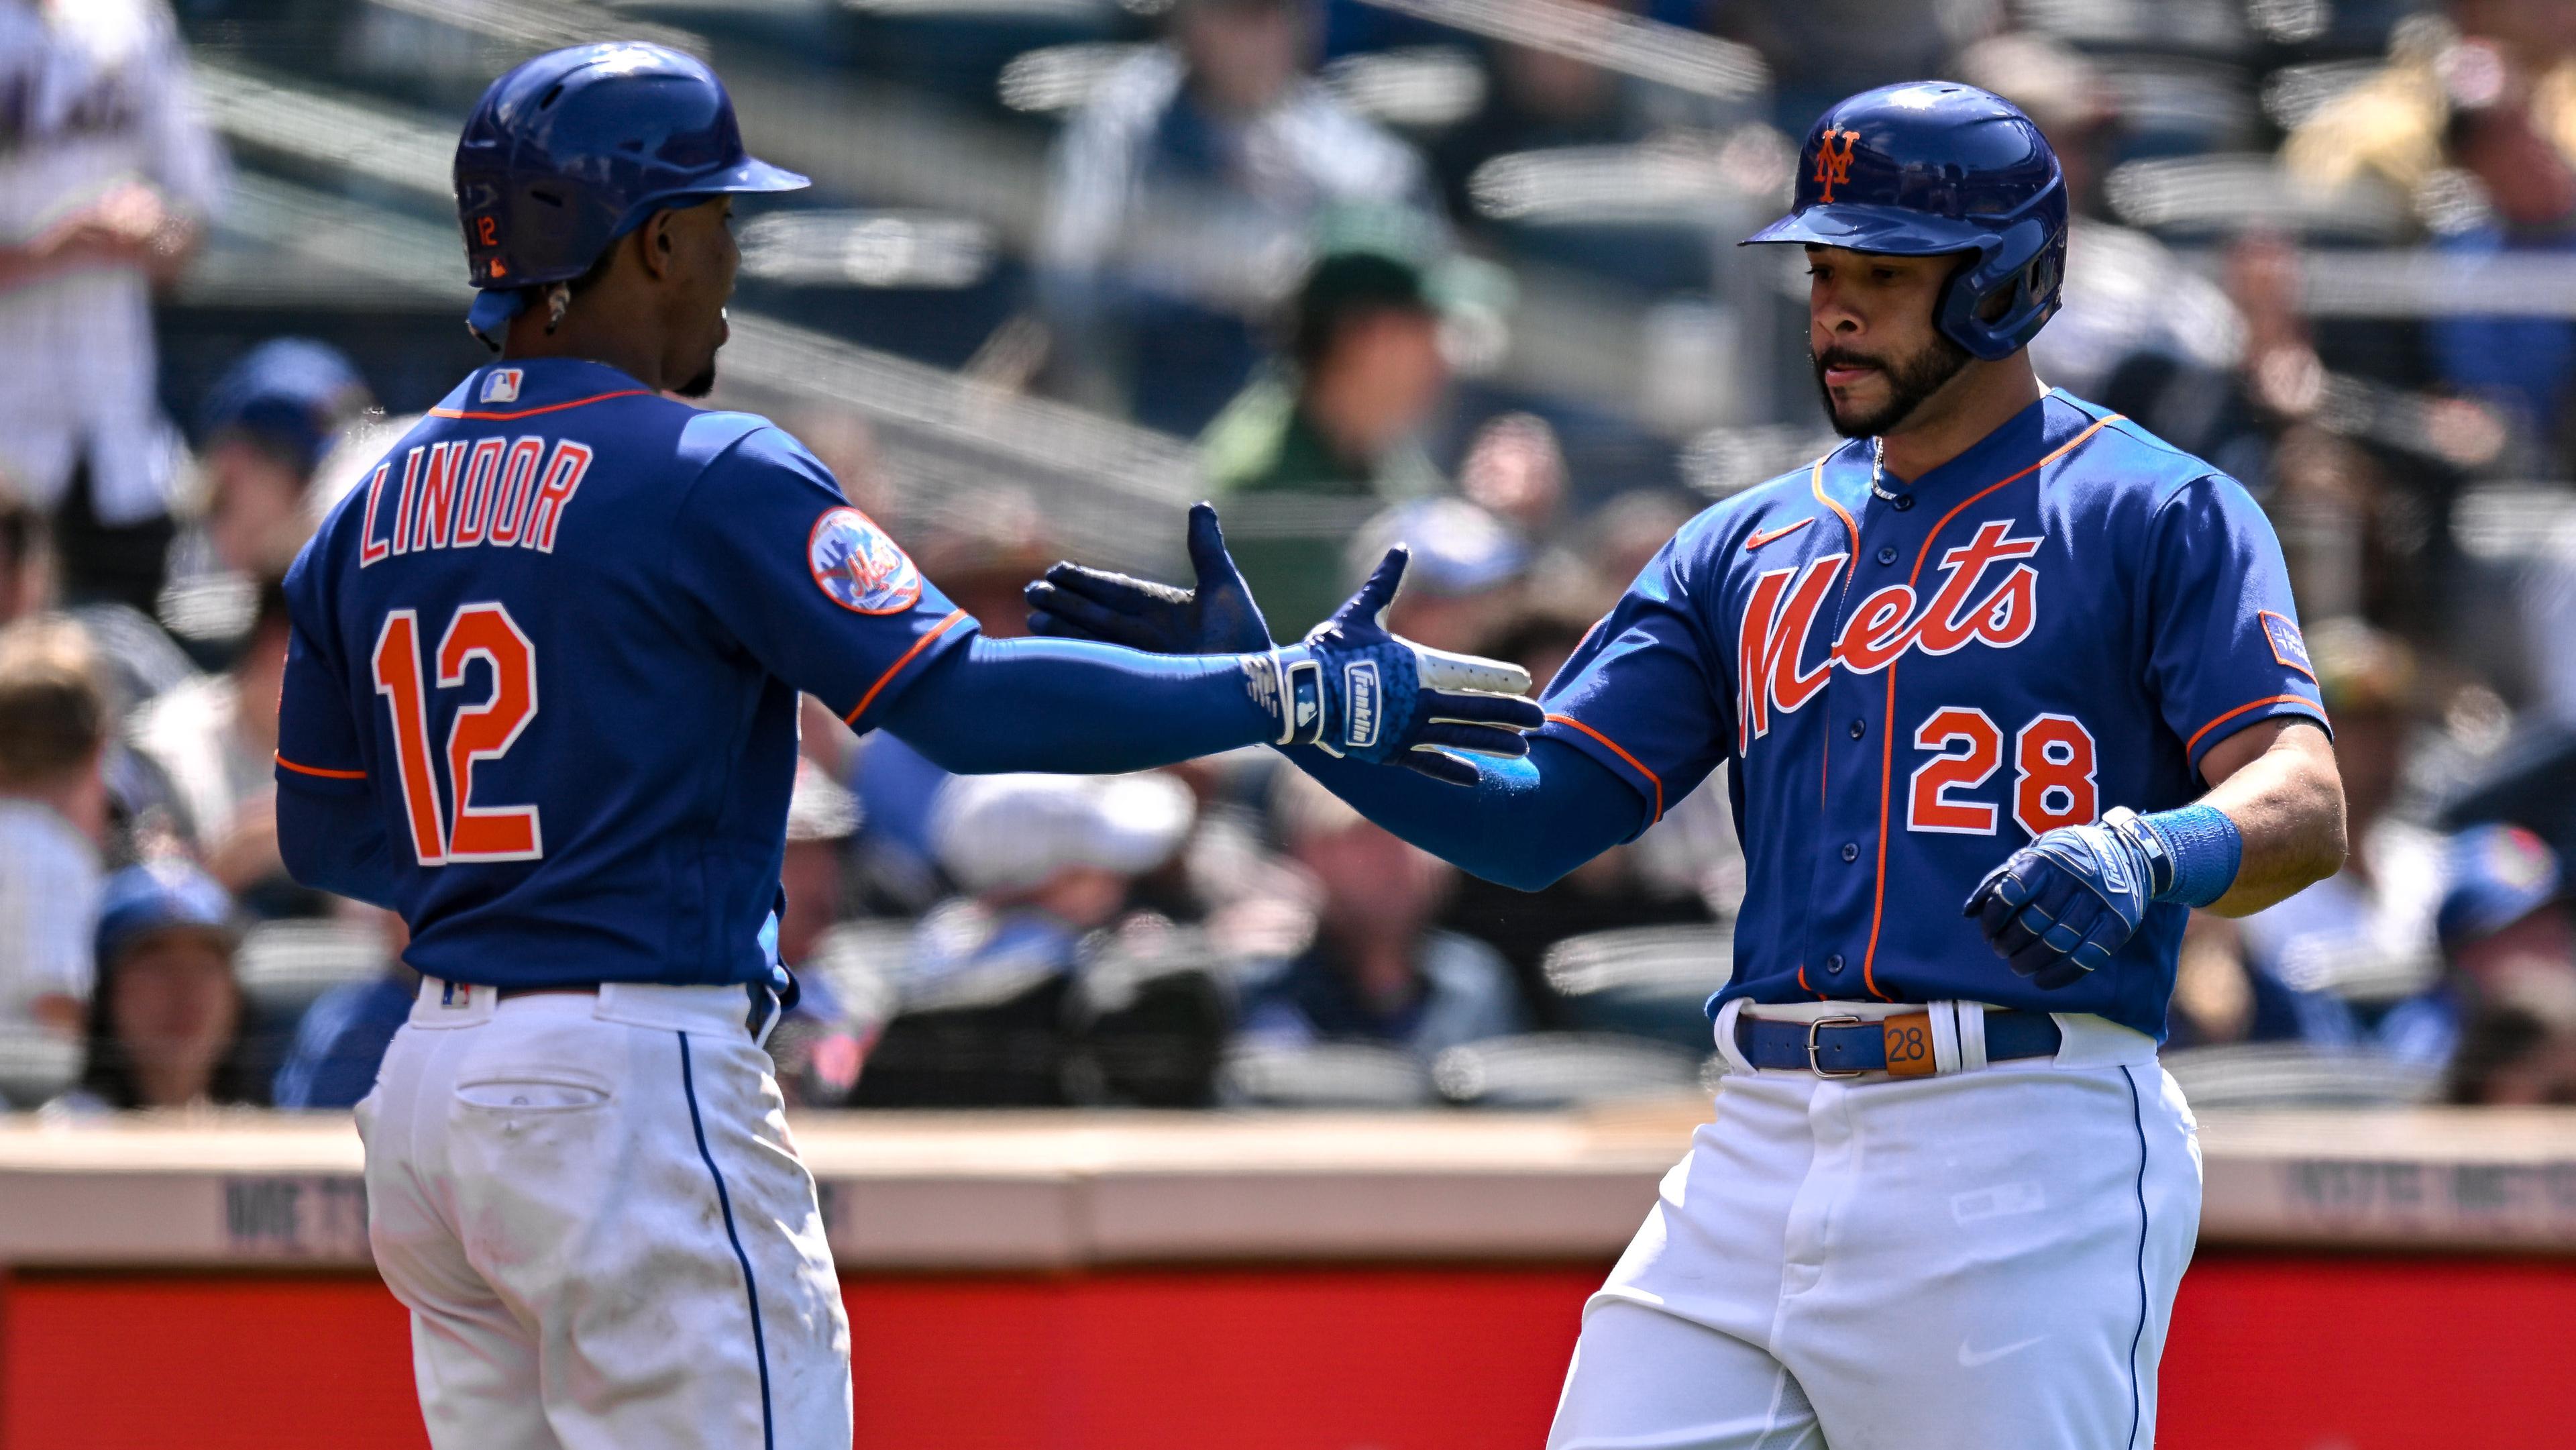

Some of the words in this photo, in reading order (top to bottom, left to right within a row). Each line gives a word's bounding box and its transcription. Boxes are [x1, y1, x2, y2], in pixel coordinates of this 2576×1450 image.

[476, 215, 498, 246] 12
[360, 436, 593, 568] LINDOR
[1737, 519, 2045, 758] Mets
[372, 602, 543, 866] 12
[1907, 706, 2100, 839] 28
[1888, 1027, 1925, 1062] 28
